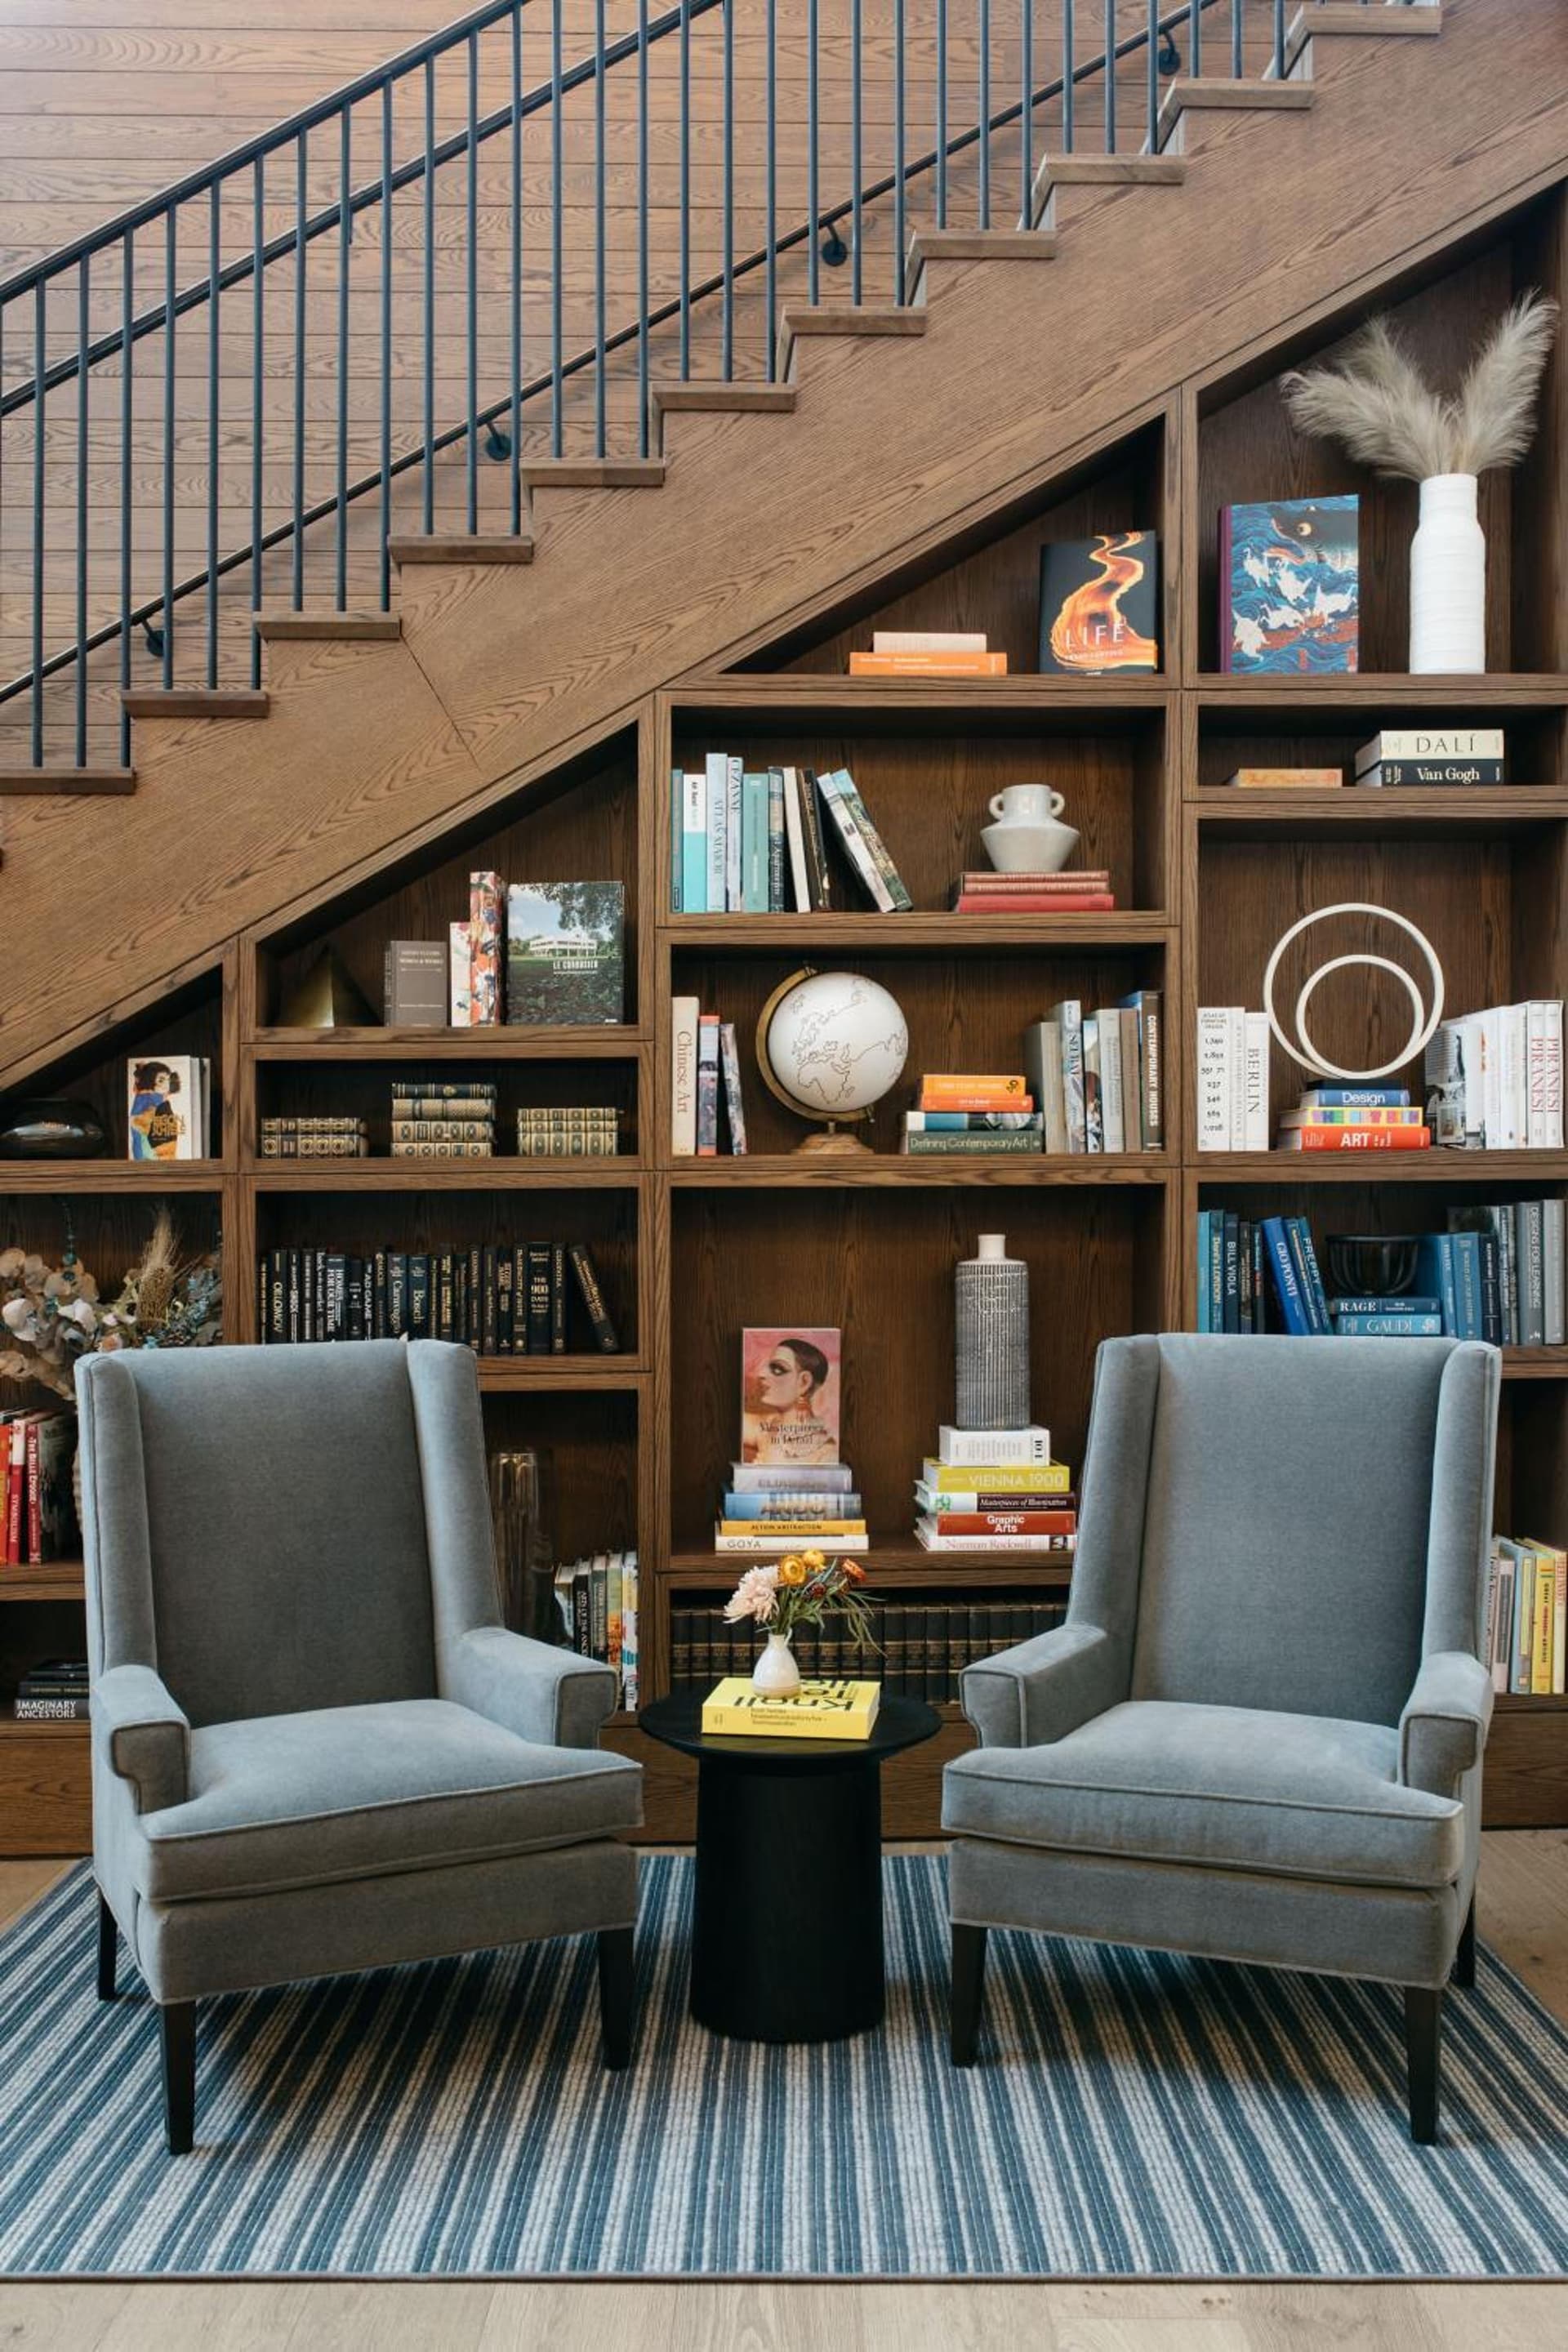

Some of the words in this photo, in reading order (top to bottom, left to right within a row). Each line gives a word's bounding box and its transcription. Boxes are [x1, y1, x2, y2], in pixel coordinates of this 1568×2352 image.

[1065, 622, 1125, 649] LIFE
[1417, 767, 1442, 781] Van
[1445, 767, 1481, 784] Gogh
[677, 1031, 693, 1086] Chinese
[1147, 1014, 1158, 1087] CONTEMPORARY
[1247, 1048, 1261, 1114] BERLIN
[1530, 1037, 1544, 1114] PIRANESI
[1546, 1037, 1561, 1114] PIRANESI
[677, 1090, 691, 1114] Art
[1148, 1091, 1159, 1127] HOUSES
[1342, 1092, 1386, 1106] Design
[911, 1136, 947, 1151] Defining
[950, 1136, 1011, 1150] Contemporary
[1013, 1134, 1028, 1148] Art
[1340, 1132, 1370, 1147] ART
[1227, 1241, 1236, 1263] BILL
[1227, 1264, 1236, 1295] VIOLA
[1531, 1264, 1542, 1309] LEARNING
[364, 1290, 372, 1320] GAME
[413, 1290, 425, 1324] Bosch
[1339, 1301, 1377, 1312] RAGE
[969, 1474, 1025, 1488] VIENNA
[1029, 1472, 1065, 1487] 1900
[10, 1494, 20, 1543] SYMBOLISM
[987, 1515, 1026, 1527] Graphic
[994, 1524, 1018, 1534] Arts
[727, 1538, 762, 1549] GOYA
[16, 1699, 77, 1710] IMAGINARY
[16, 1710, 77, 1719] ANCESTORS
